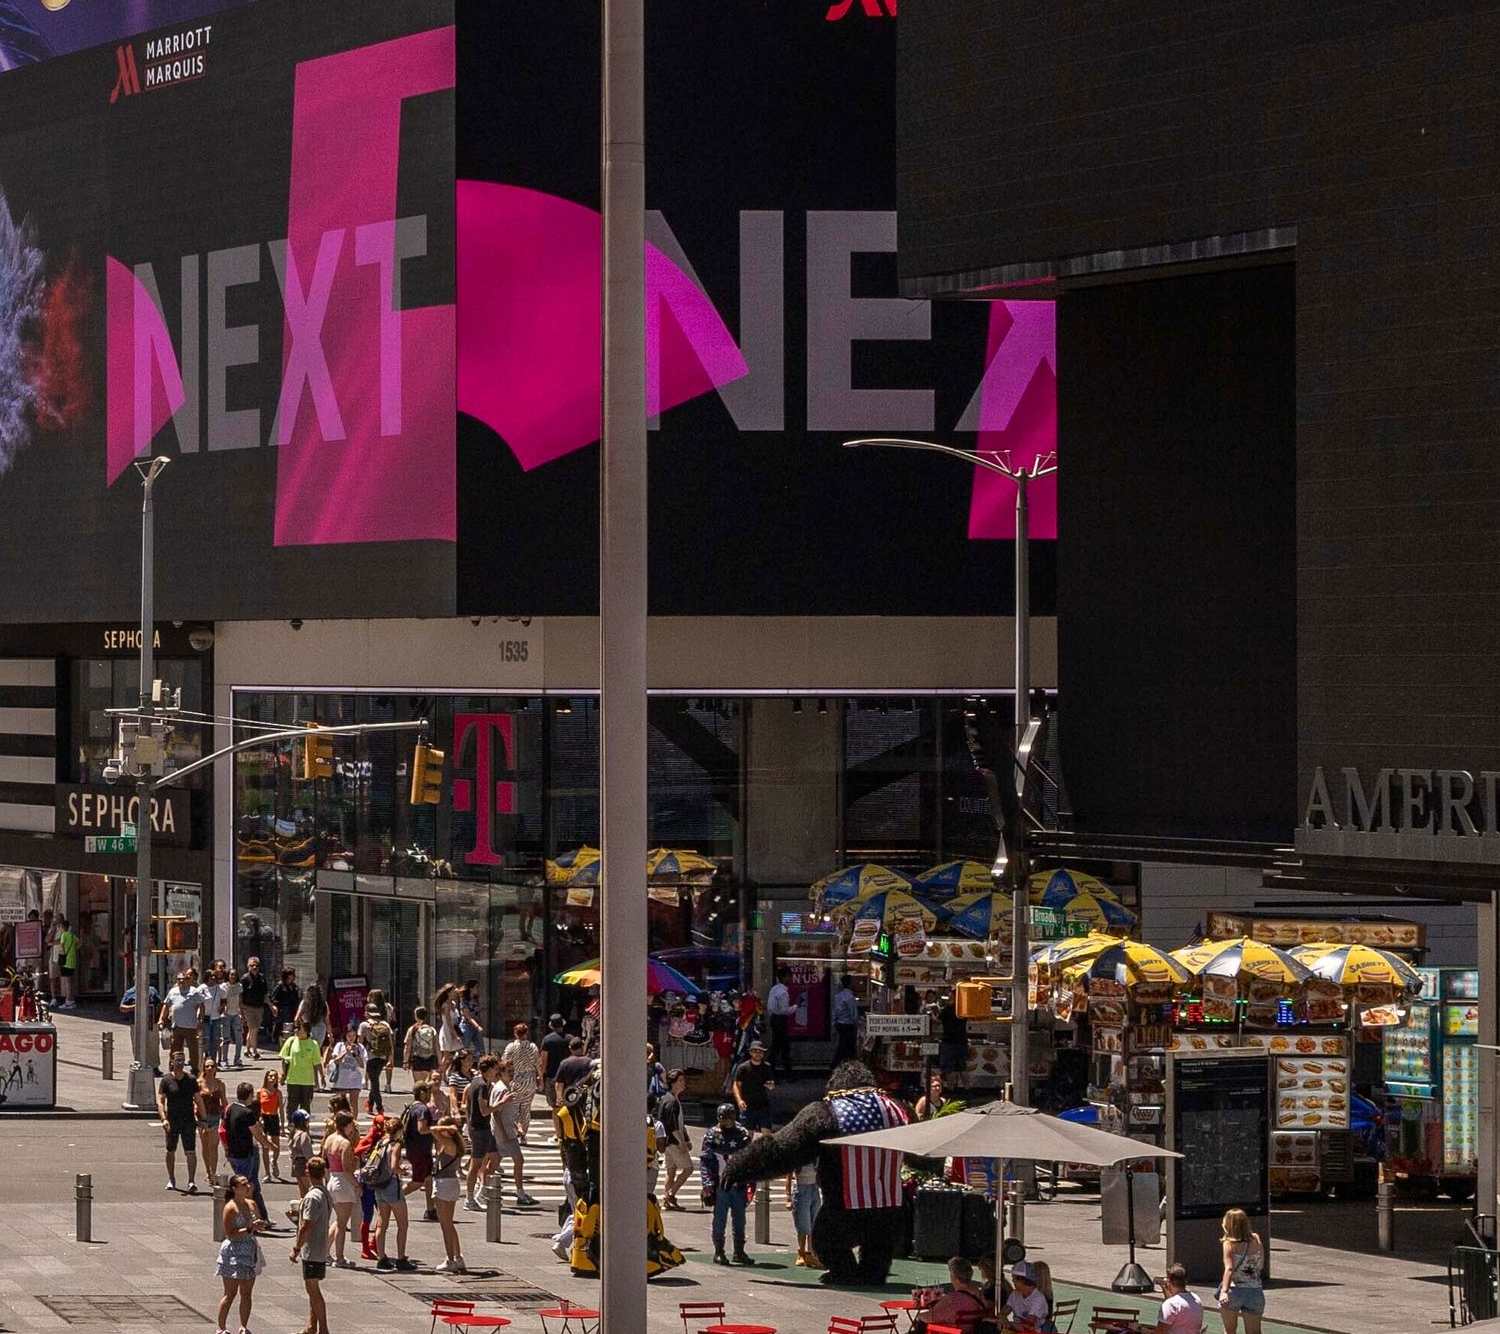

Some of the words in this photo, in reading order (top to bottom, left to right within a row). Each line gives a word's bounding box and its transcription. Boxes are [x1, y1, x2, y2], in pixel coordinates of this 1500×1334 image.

[146, 25, 212, 60] MARRIOTT
[146, 55, 204, 87] MARQUIS
[133, 212, 427, 457] NEXT
[500, 641, 528, 662] 1535
[98, 839, 107, 850] W
[111, 838, 124, 850] 46
[1035, 909, 1065, 926] Broadway
